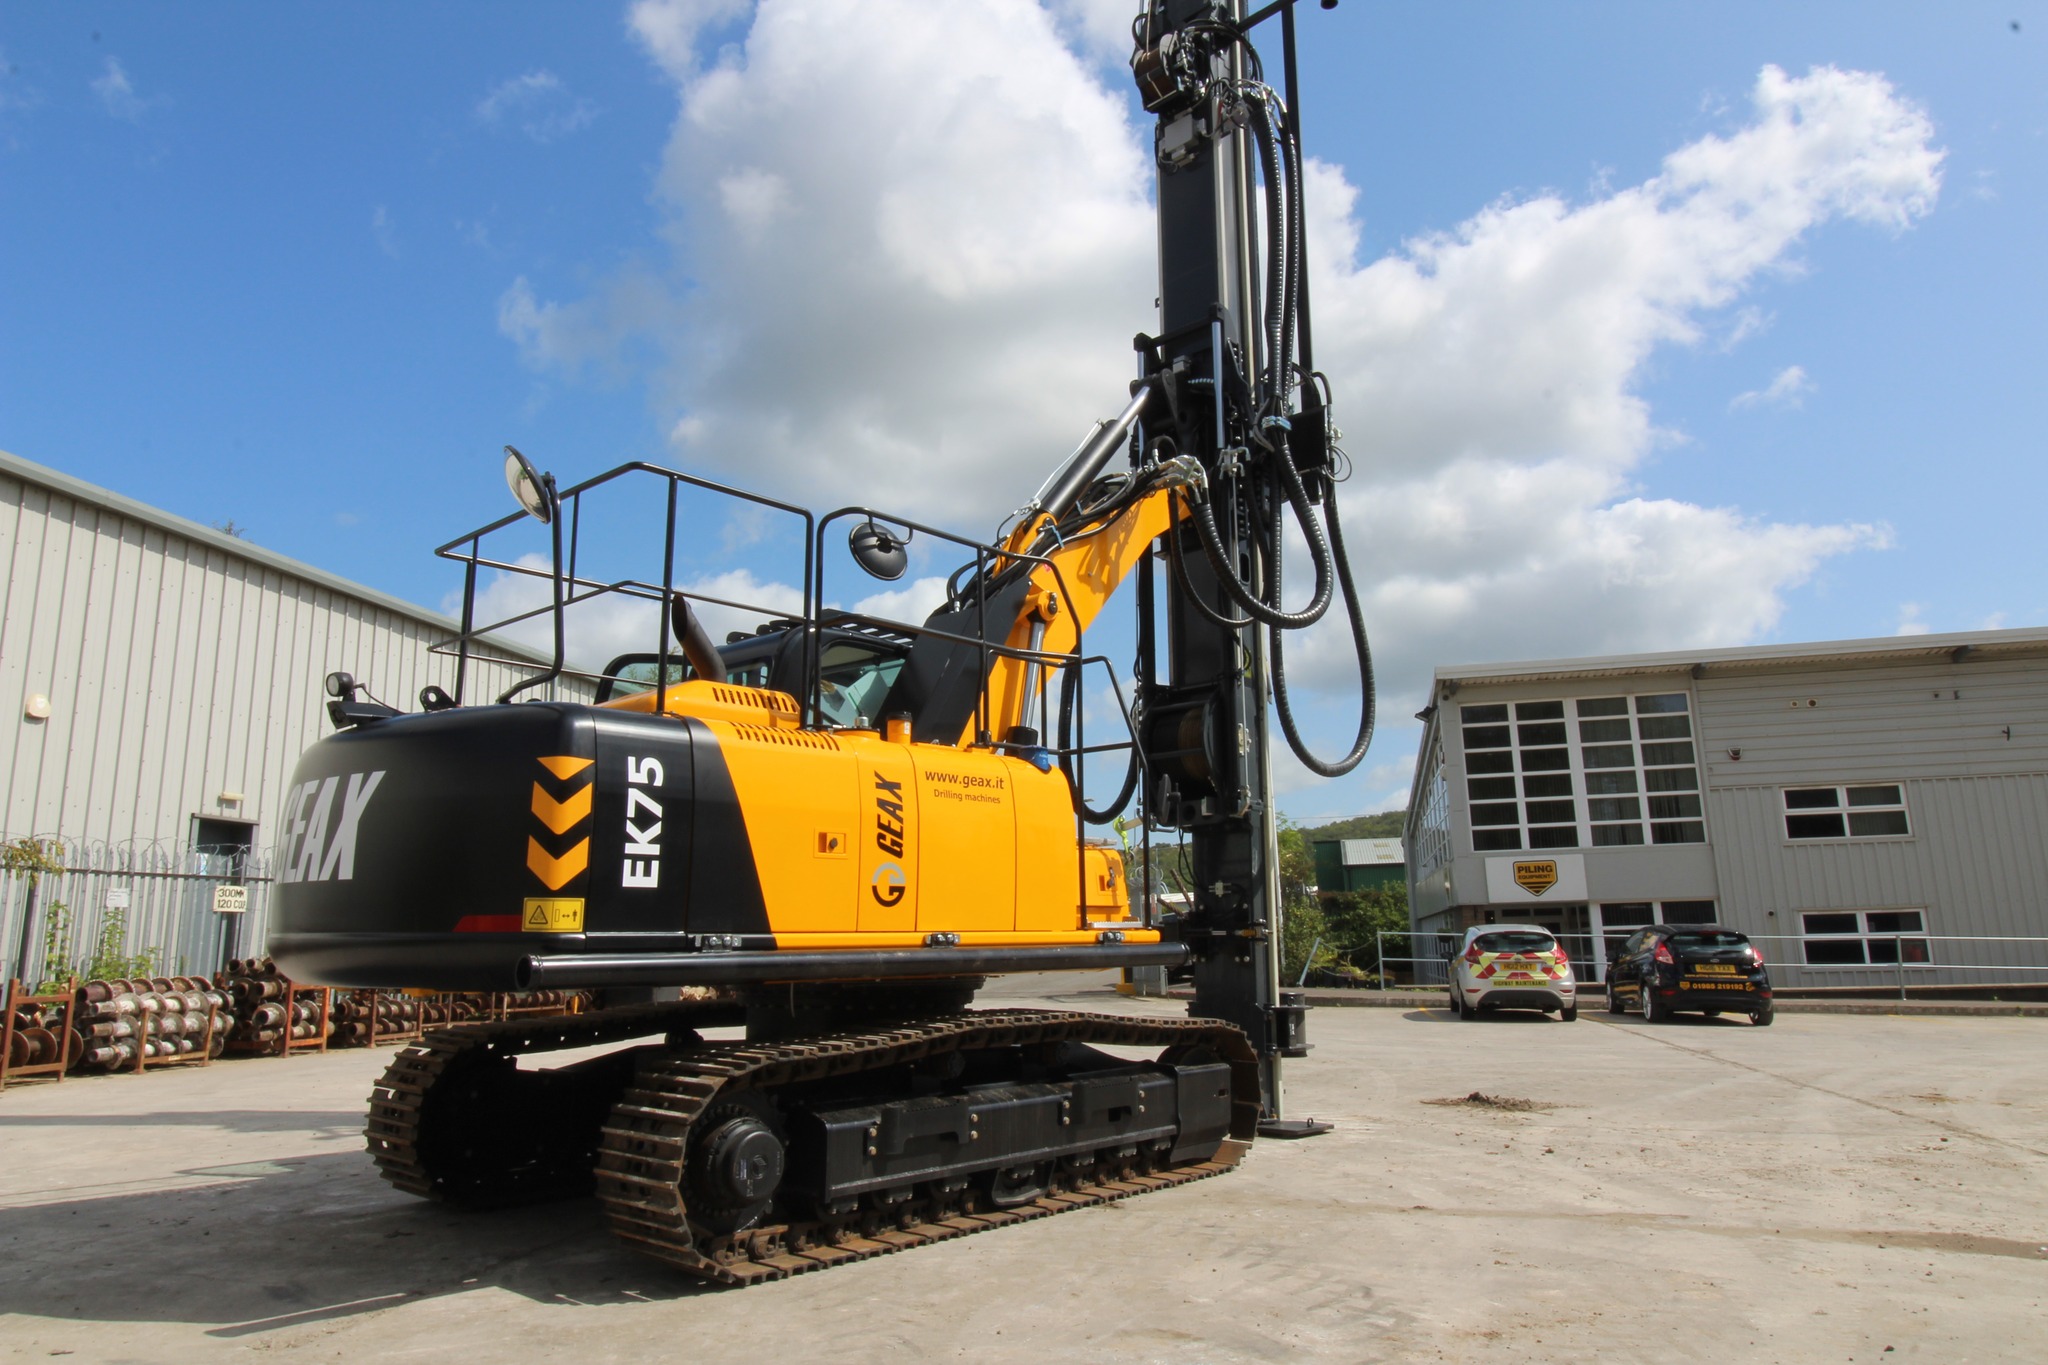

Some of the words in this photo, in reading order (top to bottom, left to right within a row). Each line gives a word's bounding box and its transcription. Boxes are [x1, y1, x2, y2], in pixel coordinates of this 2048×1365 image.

[925, 770, 1004, 789] www.geax.it
[933, 789, 963, 802] Drilling
[964, 793, 1001, 804] machines
[622, 755, 664, 888] EK75
[873, 770, 904, 860] GEAX
[276, 770, 387, 885] GEAX
[1517, 865, 1553, 873] PILING
[217, 899, 232, 909] 120
